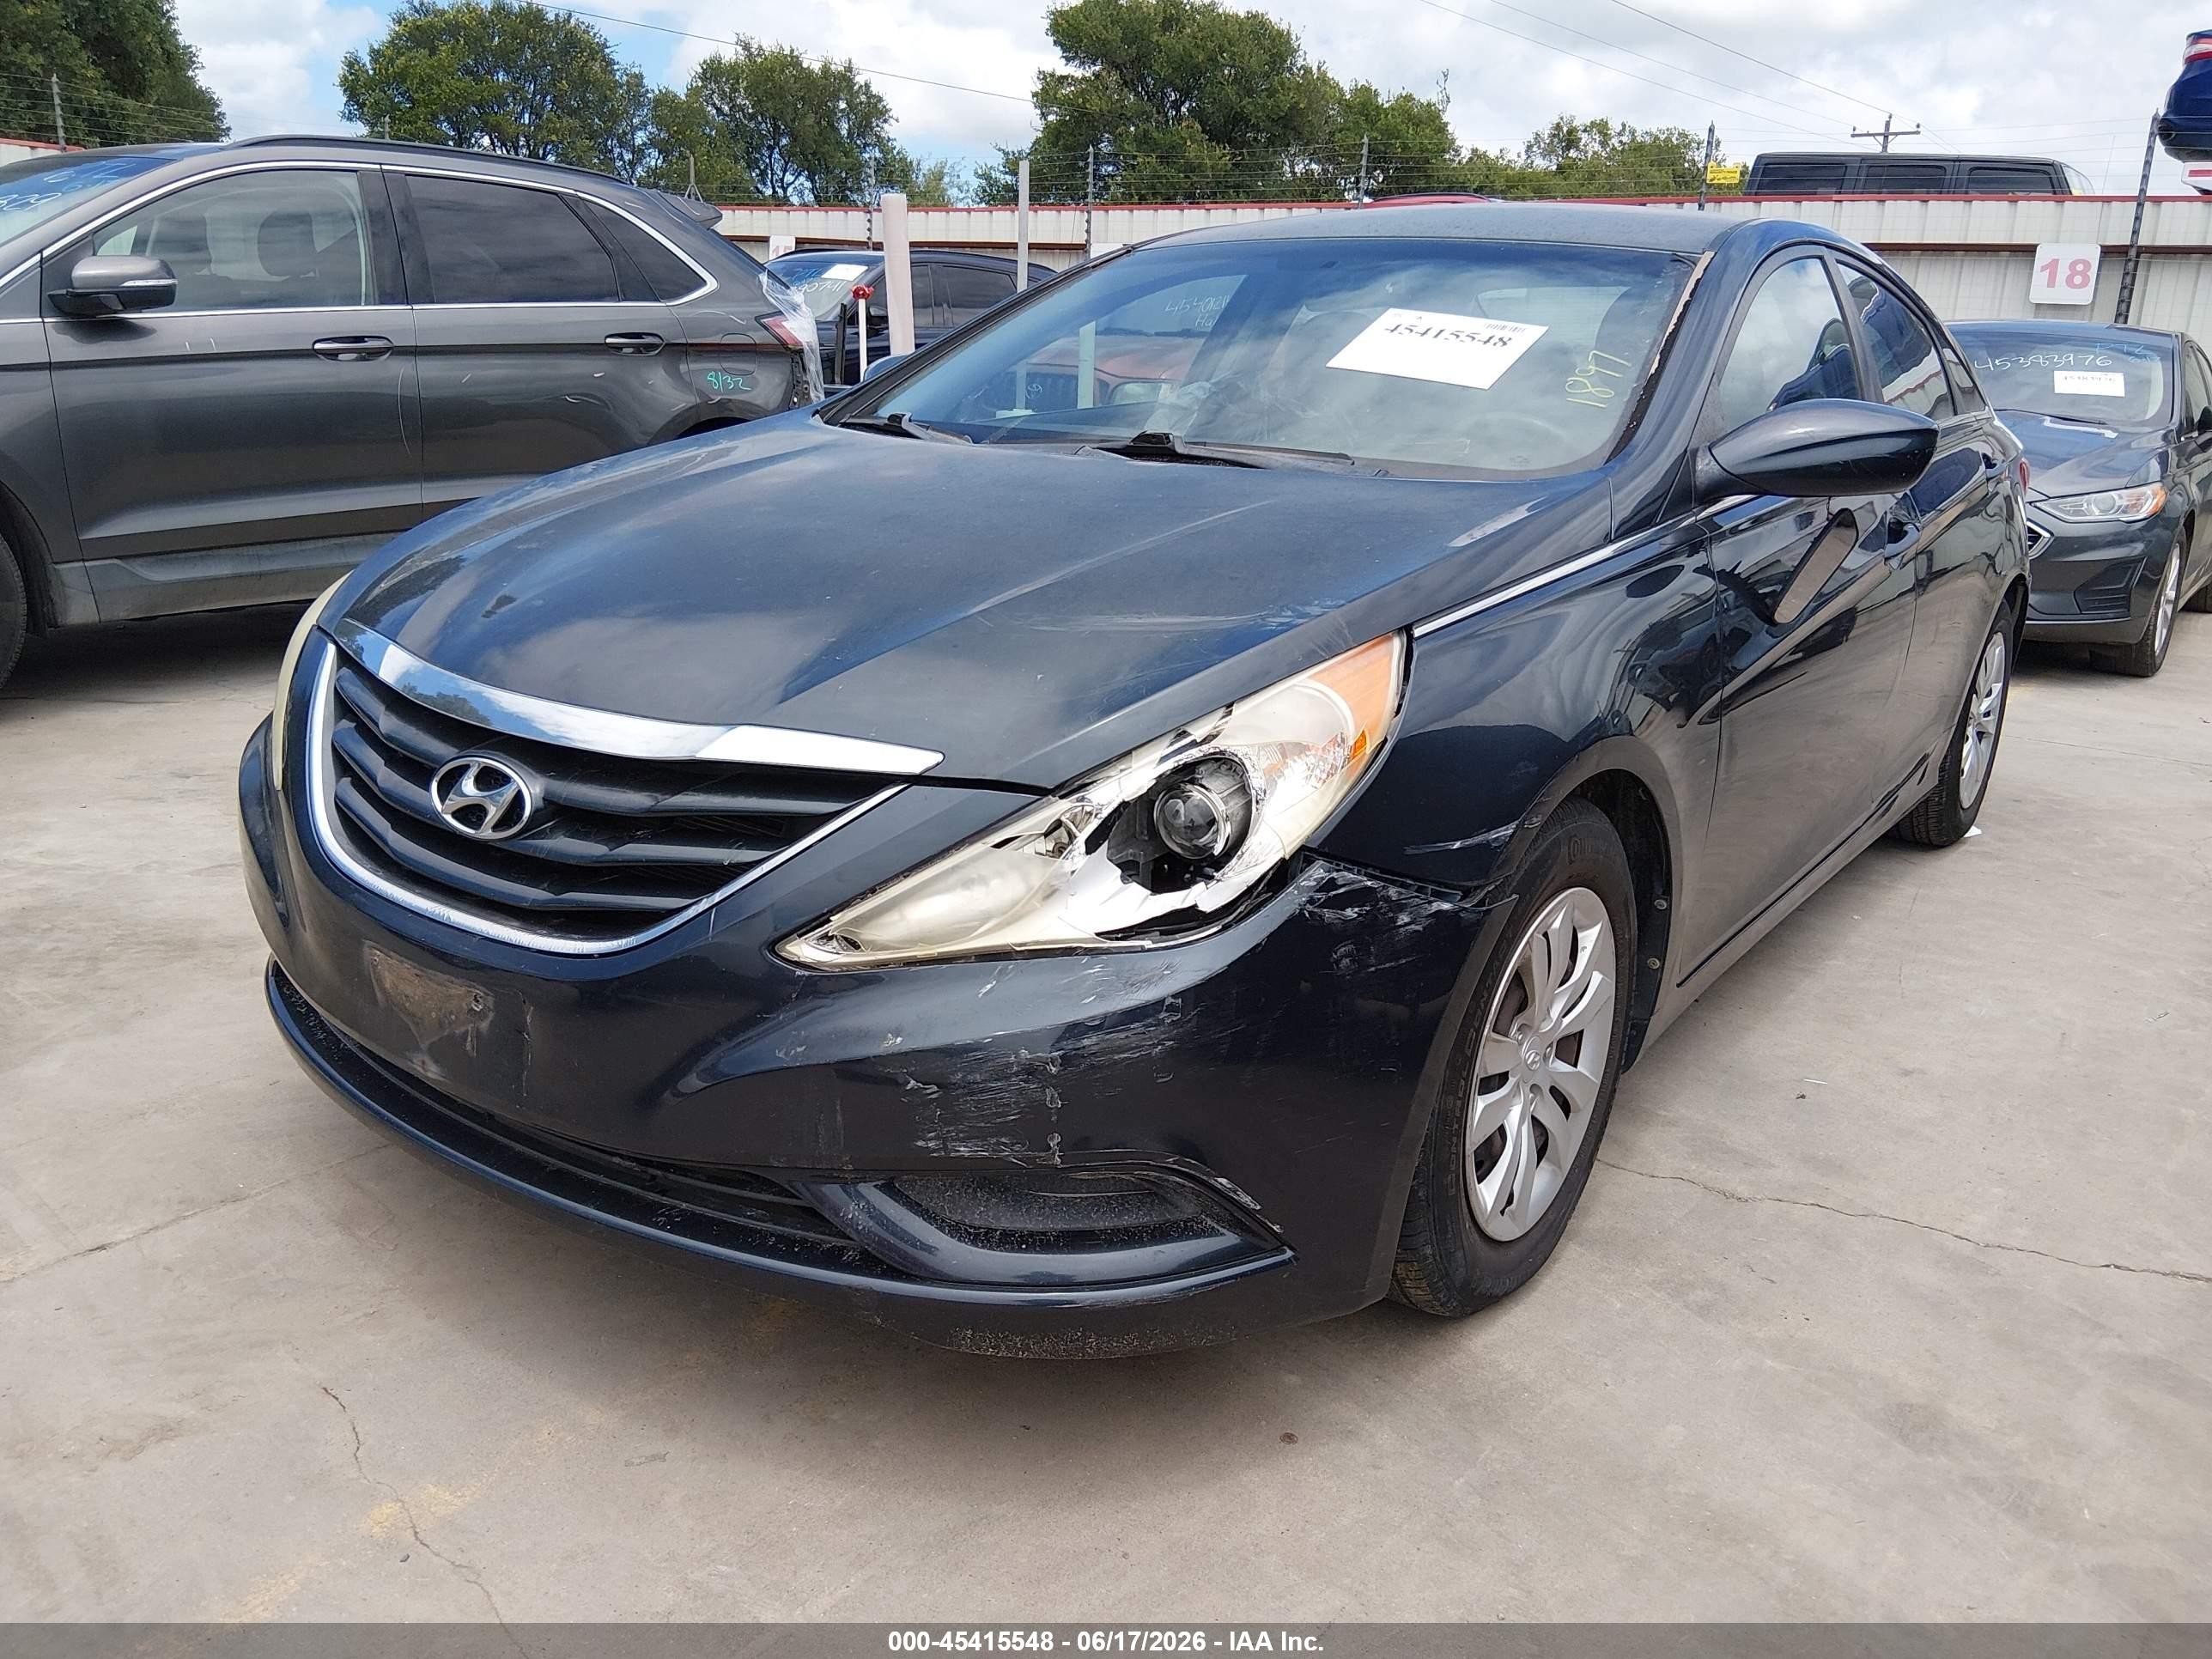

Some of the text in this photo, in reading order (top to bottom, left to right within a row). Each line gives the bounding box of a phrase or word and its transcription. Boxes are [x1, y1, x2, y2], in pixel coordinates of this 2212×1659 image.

[2039, 258, 2093, 289] 18
[1384, 323, 1513, 348] 45415548
[1974, 354, 2112, 372] 45383976
[1565, 349, 1632, 409] 1897
